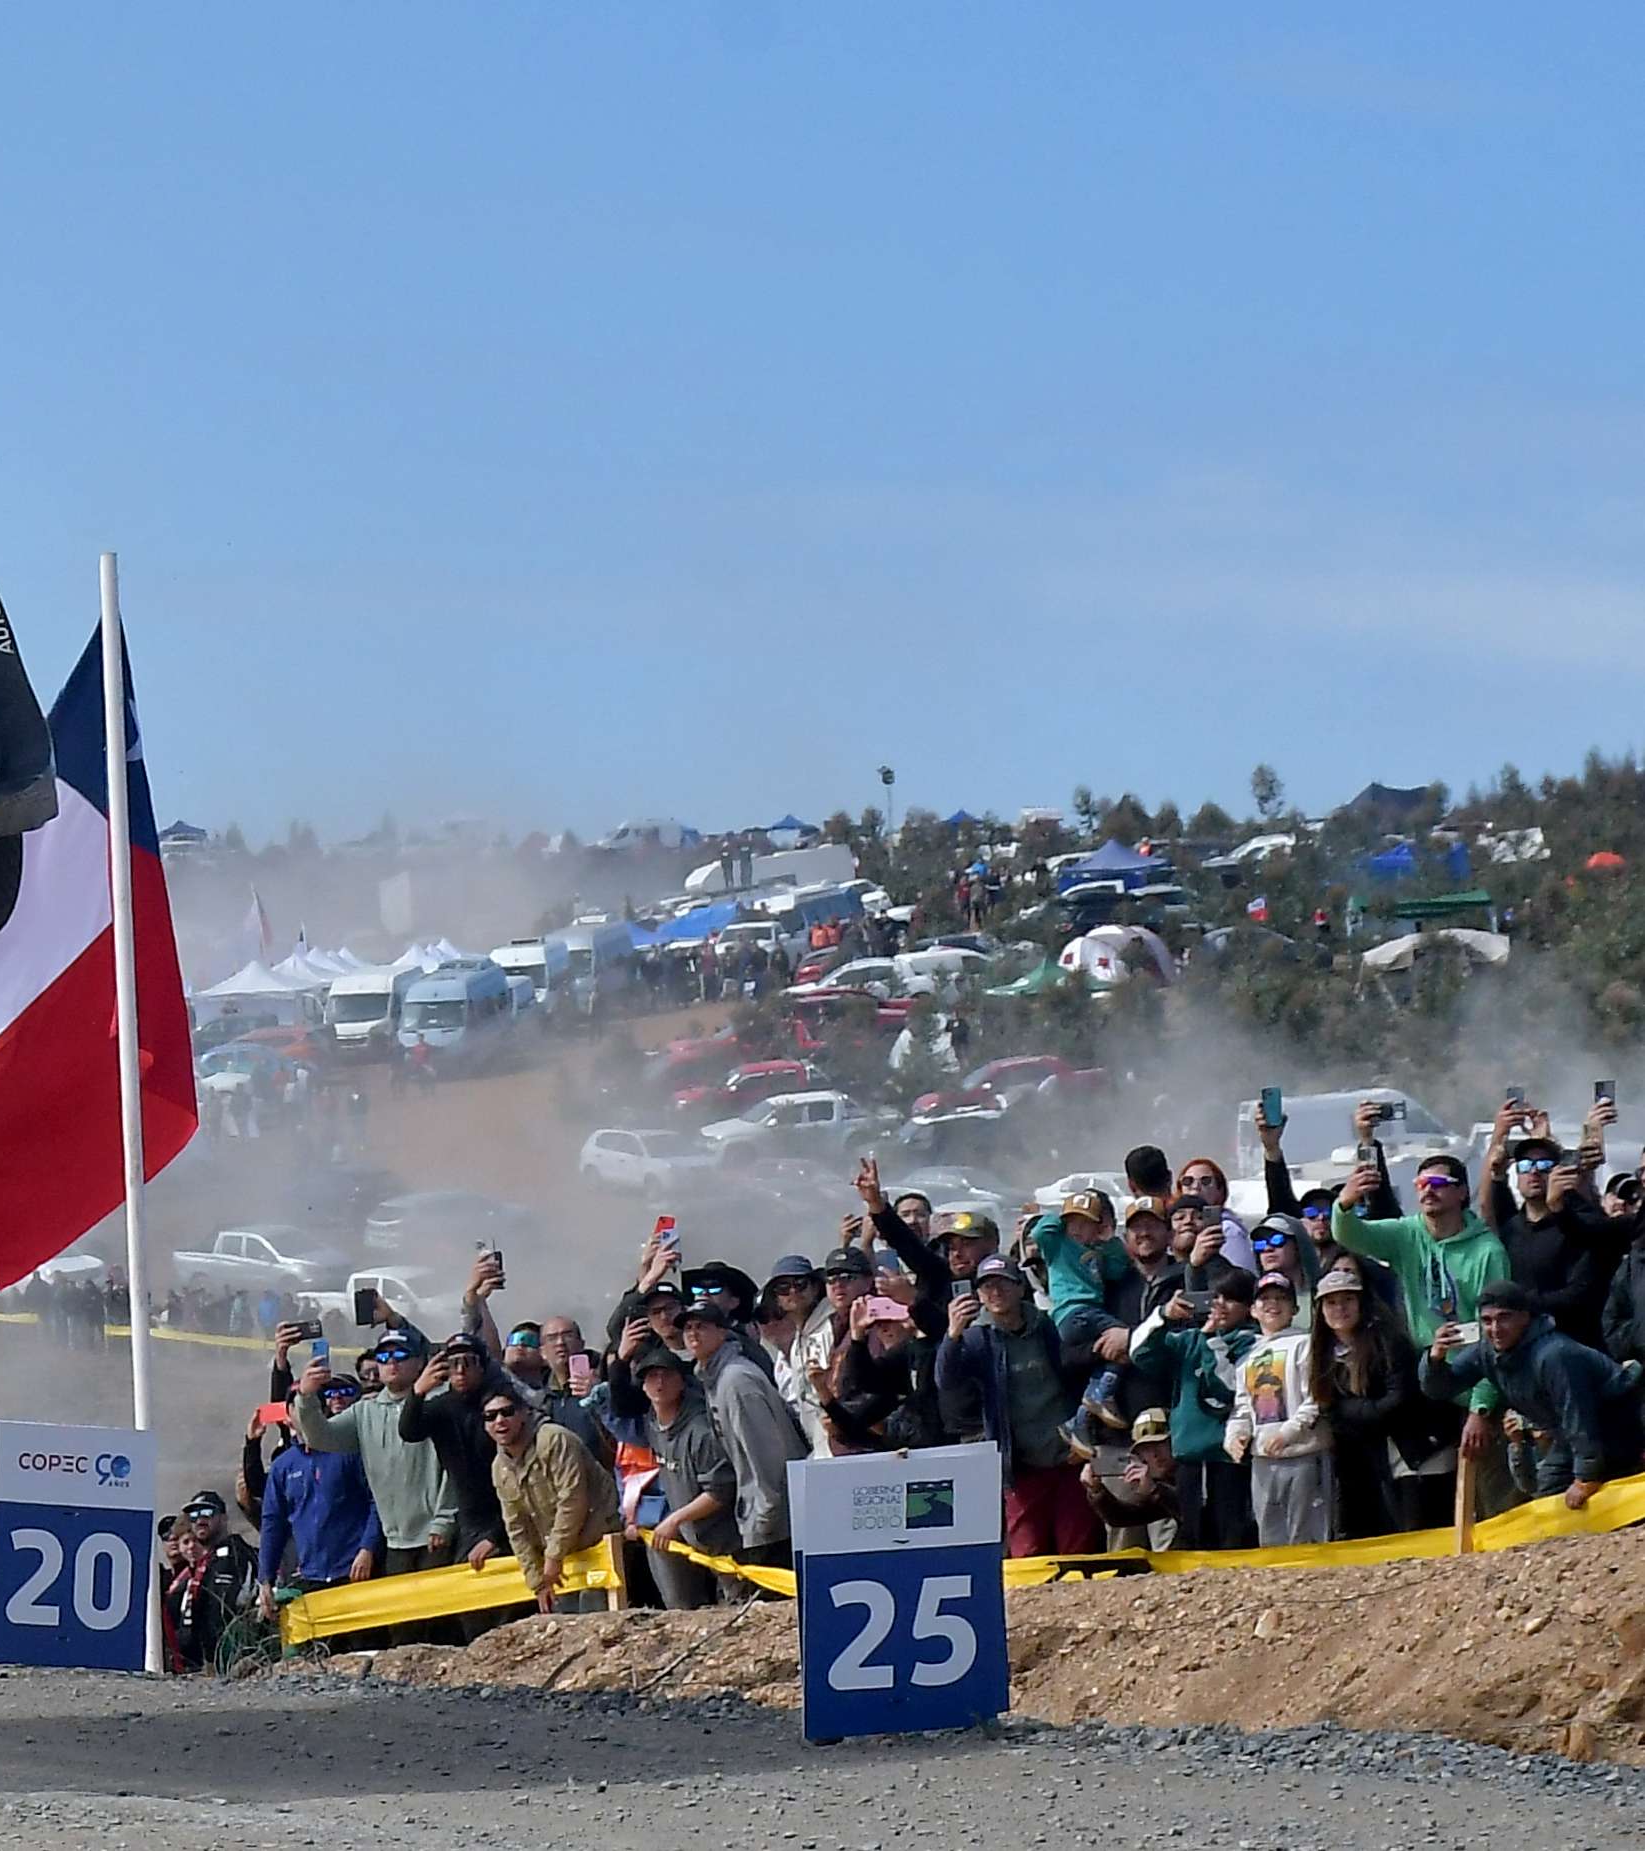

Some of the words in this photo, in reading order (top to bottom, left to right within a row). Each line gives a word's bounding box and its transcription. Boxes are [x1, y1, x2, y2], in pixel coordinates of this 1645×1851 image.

[18, 1453, 89, 1474] COPEC
[5, 1528, 132, 1631] 20
[827, 1574, 977, 1692] 25
